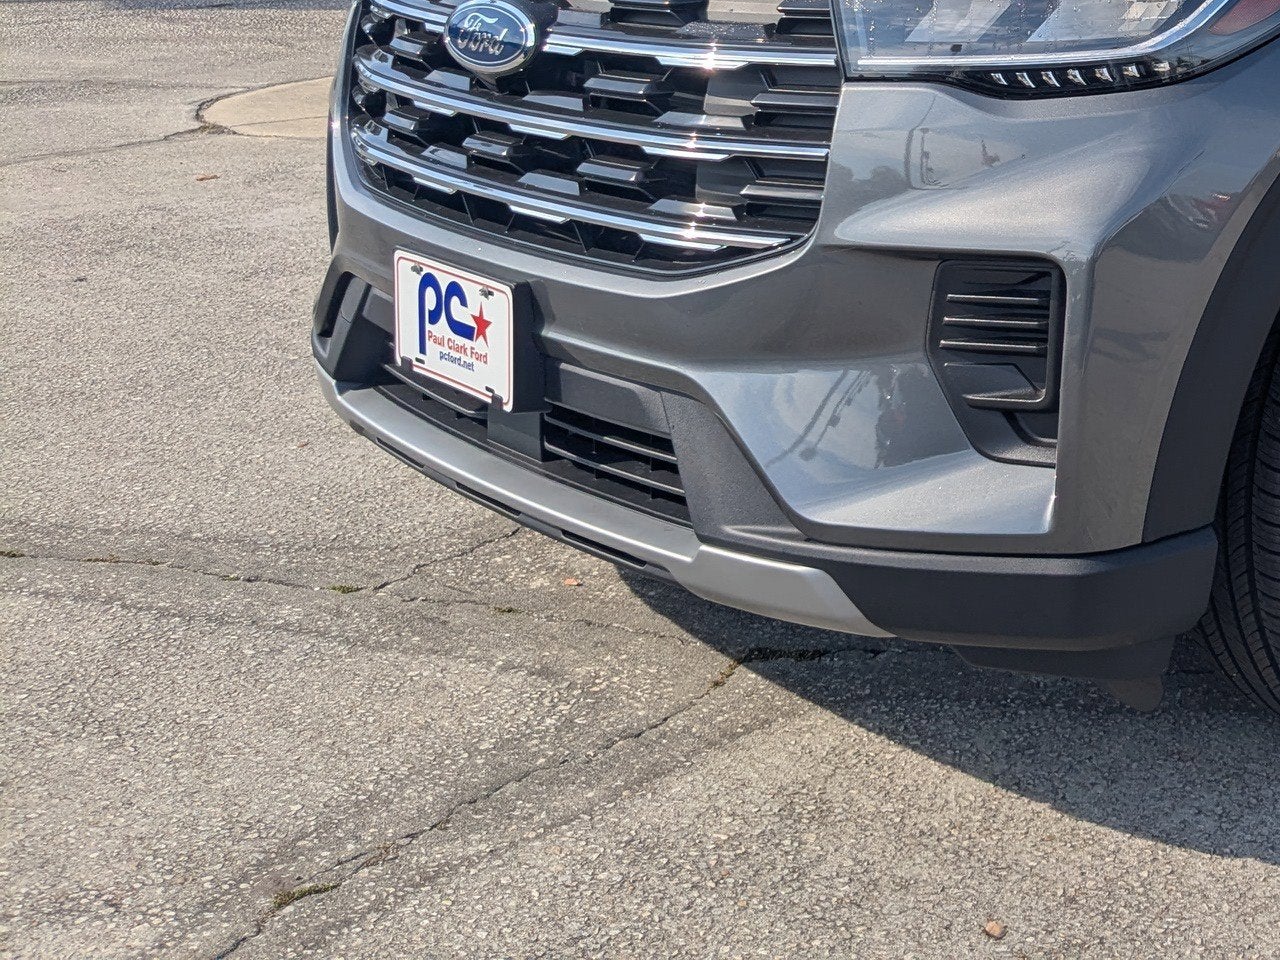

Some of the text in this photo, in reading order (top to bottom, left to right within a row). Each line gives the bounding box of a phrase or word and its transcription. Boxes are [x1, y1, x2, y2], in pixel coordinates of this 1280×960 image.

[457, 12, 508, 56] Ford
[427, 329, 489, 366] Paul Clark Ford
[439, 350, 475, 373] pcford.net
